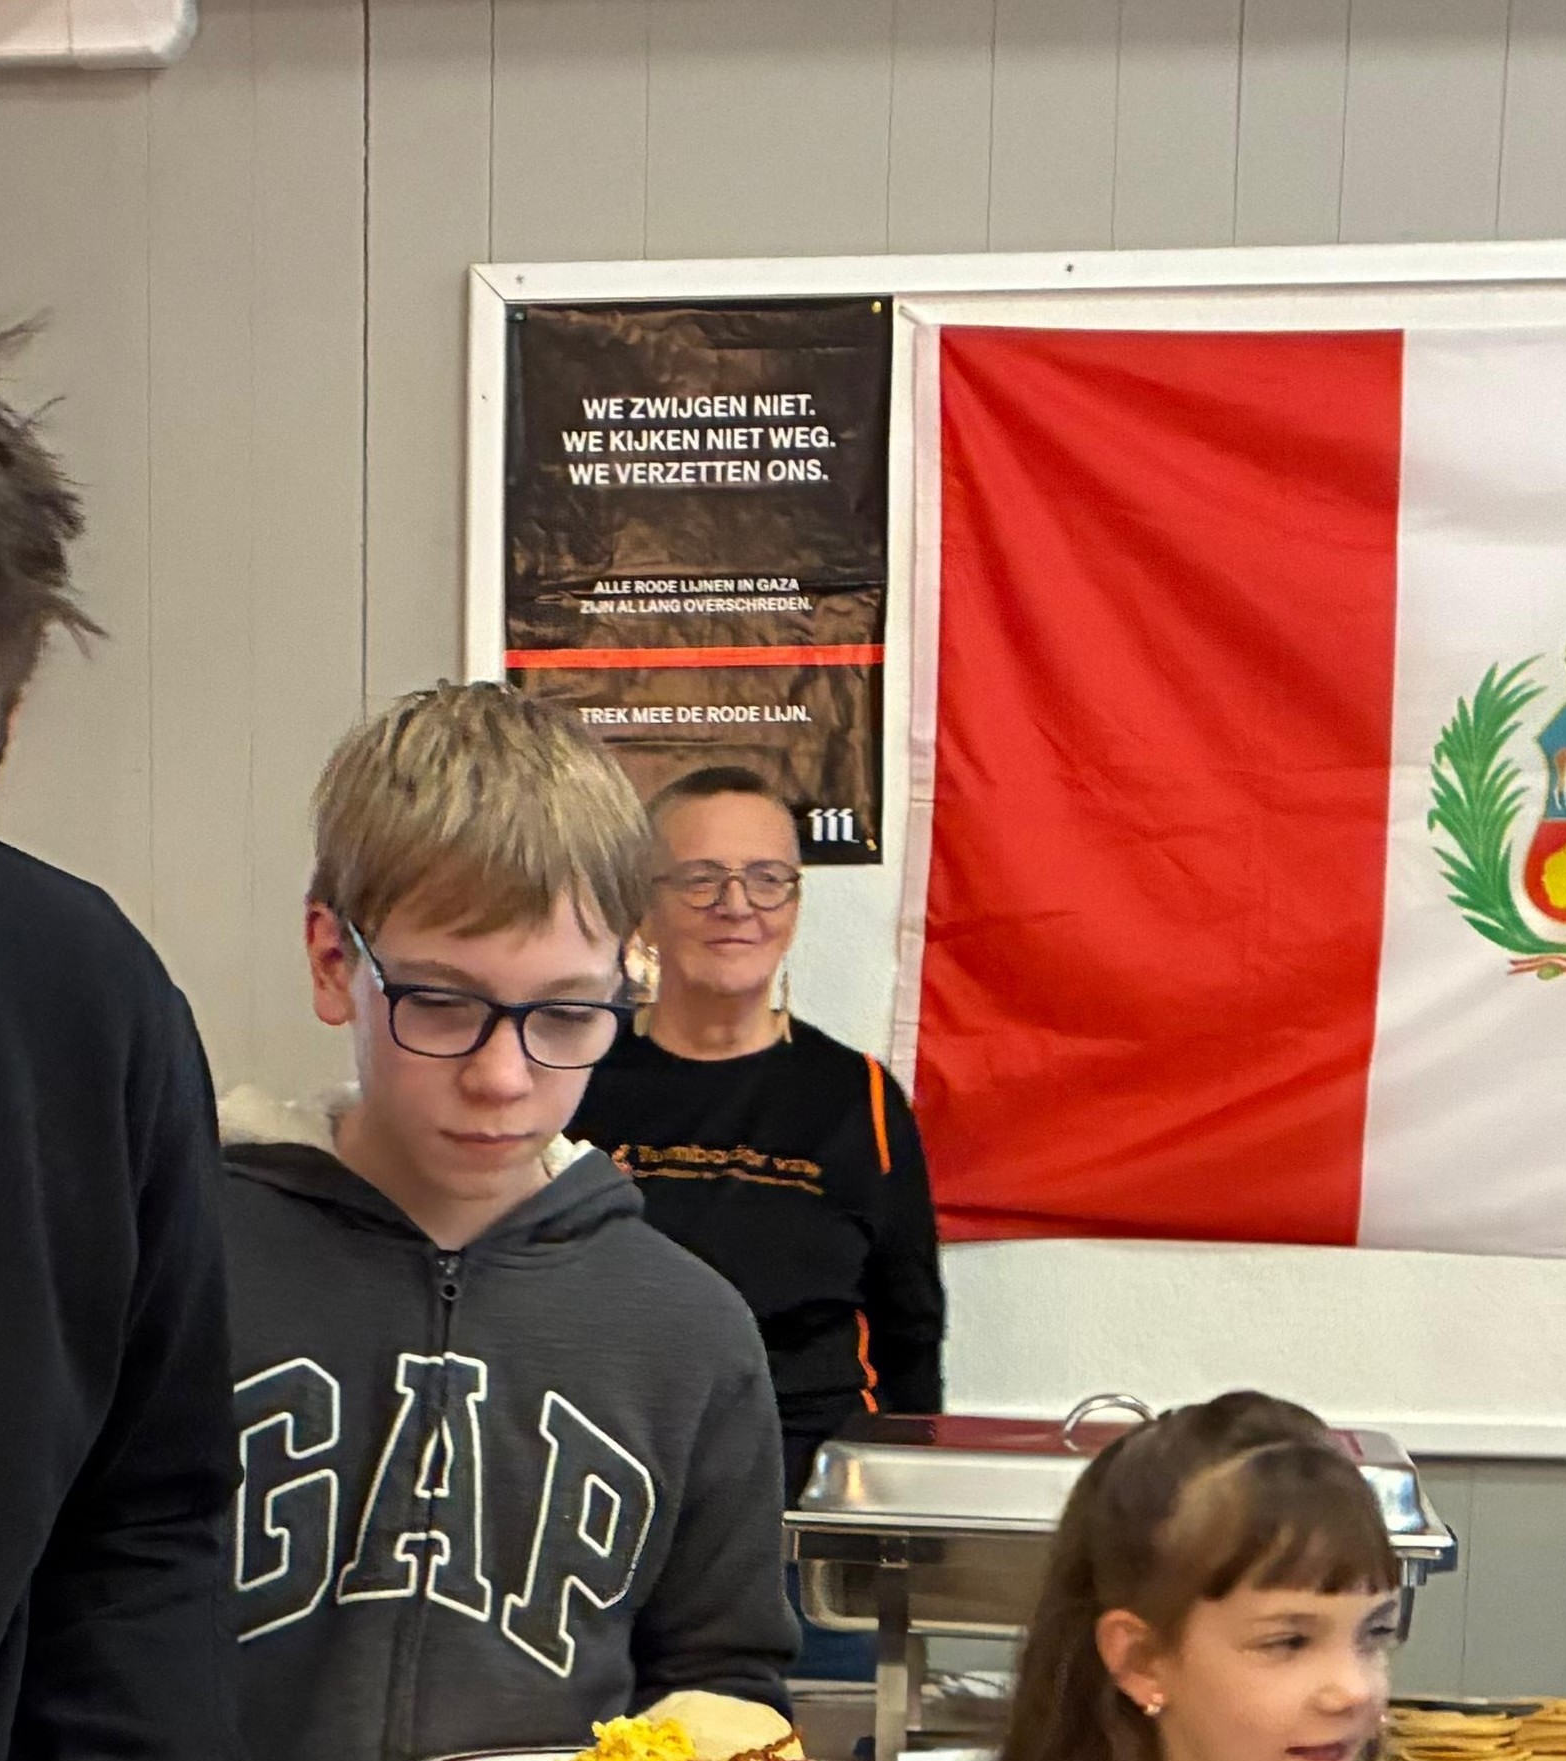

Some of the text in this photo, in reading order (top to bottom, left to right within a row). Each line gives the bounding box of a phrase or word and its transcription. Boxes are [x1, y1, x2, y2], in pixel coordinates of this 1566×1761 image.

[582, 393, 816, 419] WE ZWIJGEN NIET.
[562, 426, 836, 452] WE KIJKEN NIET WEG.
[569, 458, 828, 485] WE VERZETTEN ONS.
[594, 577, 800, 594] ALLE RODE LIJNEN IN GAZA
[580, 596, 813, 614] ZIJN AL LANG OVERSCHREDEN.
[579, 704, 812, 723] TREK MEE DE RODE LIJN.
[234, 1352, 657, 1679] GAP
